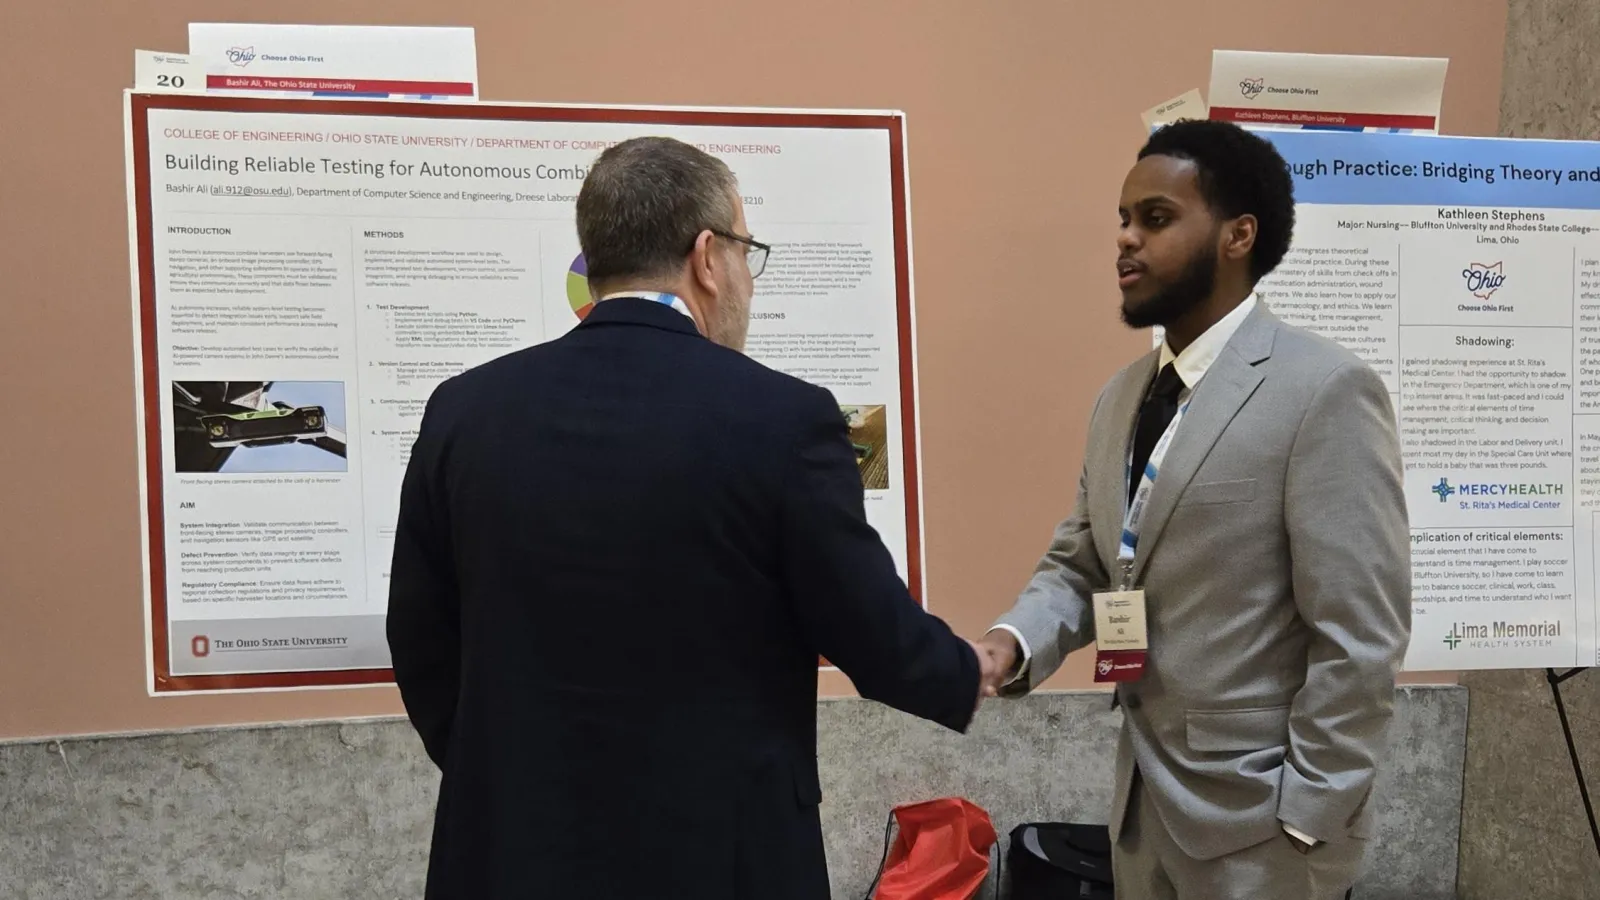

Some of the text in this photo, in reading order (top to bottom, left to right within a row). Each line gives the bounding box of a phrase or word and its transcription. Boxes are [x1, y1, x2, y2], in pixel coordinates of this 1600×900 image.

[226, 49, 256, 63] Ohio
[156, 75, 185, 88] 20
[226, 79, 249, 87] Bashir
[250, 80, 262, 88] Ali,
[320, 82, 356, 91] University
[1240, 81, 1264, 96] Ohio
[163, 128, 220, 139] COLLEGE
[222, 130, 239, 140] OF
[242, 131, 323, 142] ENGINEERING
[331, 133, 361, 143] OHIO
[364, 134, 399, 144] STATE
[401, 136, 468, 147] UNIVERSITY
[476, 138, 550, 149] DEPARTMENT
[552, 140, 568, 149] OF
[709, 144, 781, 155] ENGINEERING
[165, 154, 589, 180] Building Reliable Testing for Autonomous Combi
[1333, 159, 1417, 176] Practice:
[1422, 162, 1495, 183] Bridging
[1499, 166, 1561, 184] Theory
[1568, 167, 1600, 182] and
[165, 183, 194, 192] Bashir
[196, 184, 208, 193] Ali
[296, 187, 350, 197] Department
[351, 188, 361, 196] of
[362, 188, 407, 199] Computer
[408, 190, 441, 199] Science
[443, 191, 460, 199] and
[461, 191, 514, 202] Engineering,
[514, 192, 545, 201] Dreese
[546, 193, 577, 202] Labora
[744, 196, 764, 205] 3210
[1438, 208, 1545, 222] Kathleen Stephens
[168, 227, 232, 235] INTRODUCTION
[1337, 220, 1364, 230] Major:
[1410, 221, 1444, 229] Bluffton
[1445, 222, 1487, 231] University
[1506, 223, 1537, 231] Rhodes
[1538, 224, 1560, 232] State
[364, 231, 404, 239] METHODS
[1476, 235, 1520, 244] Lima, Ohio
[1462, 269, 1506, 291] Ohio
[1455, 336, 1515, 348] Shadowing:
[1406, 357, 1428, 367] gained
[1430, 358, 1468, 367] shadowing
[1488, 370, 1530, 378] opportunity
[1459, 484, 1563, 494] MERCYHEALTH
[1472, 501, 1496, 509] Rita's
[1462, 533, 1473, 541] of
[1475, 533, 1511, 541] critical
[1513, 532, 1564, 540] elements:
[1443, 571, 1480, 579] University,
[1453, 620, 1561, 638] Lima Memorial
[1470, 639, 1552, 648] HEALTH SYSTEM
